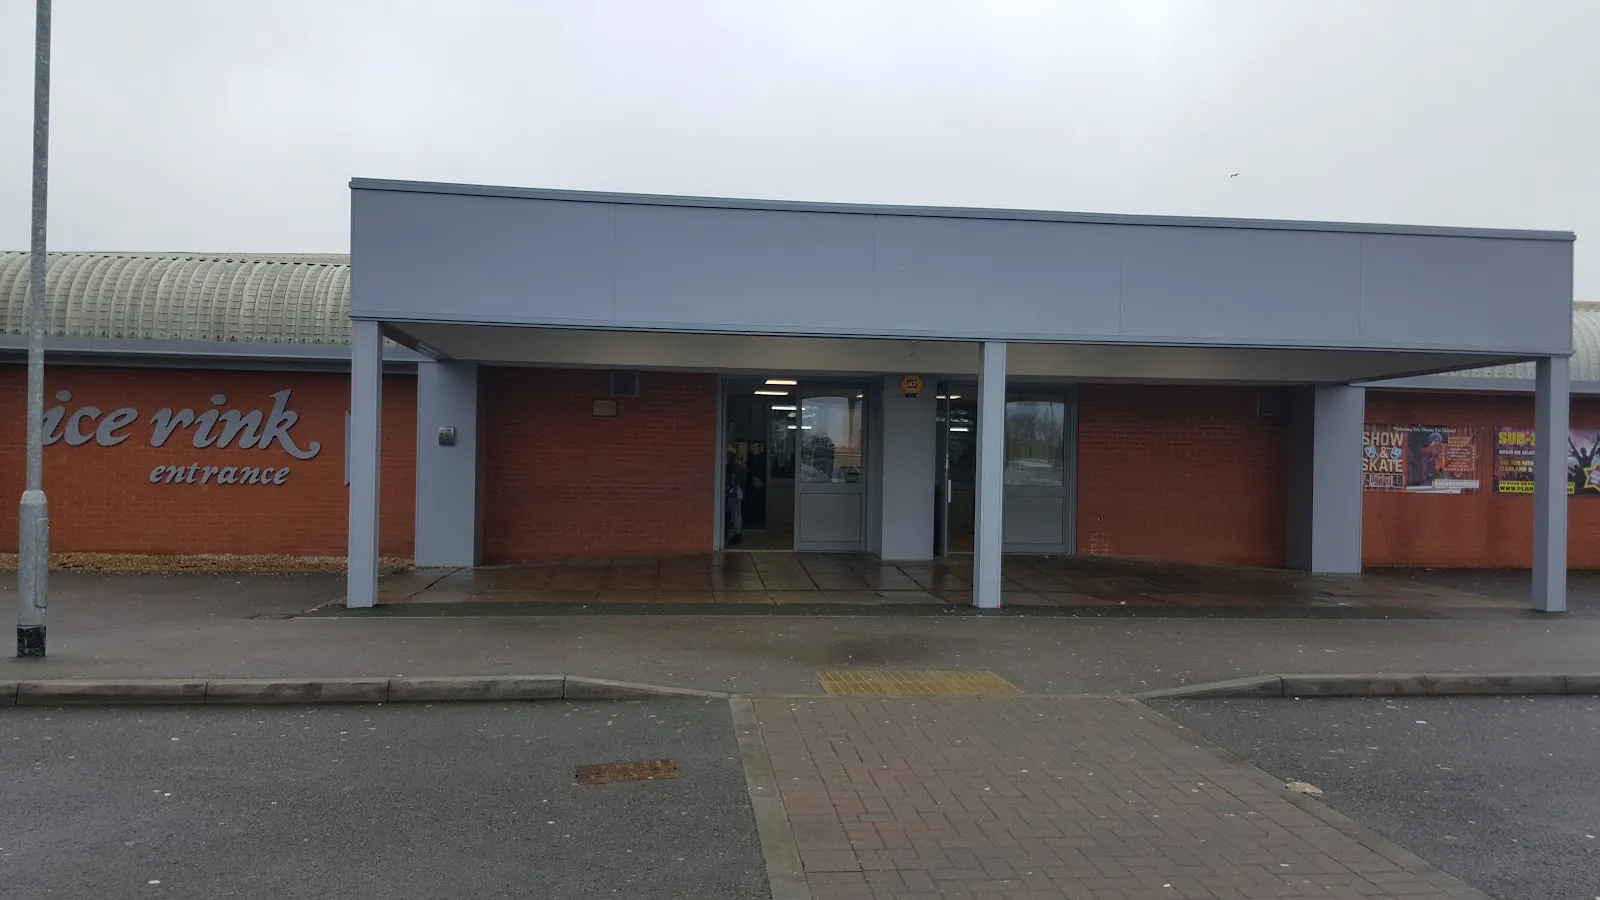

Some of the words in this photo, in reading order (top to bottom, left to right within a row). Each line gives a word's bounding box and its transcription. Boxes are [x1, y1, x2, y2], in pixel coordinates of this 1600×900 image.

[42, 390, 139, 447] ice
[148, 388, 321, 460] rink
[1363, 431, 1404, 446] SHOW
[149, 461, 291, 486] entrance
[1362, 459, 1404, 472] SKATE
